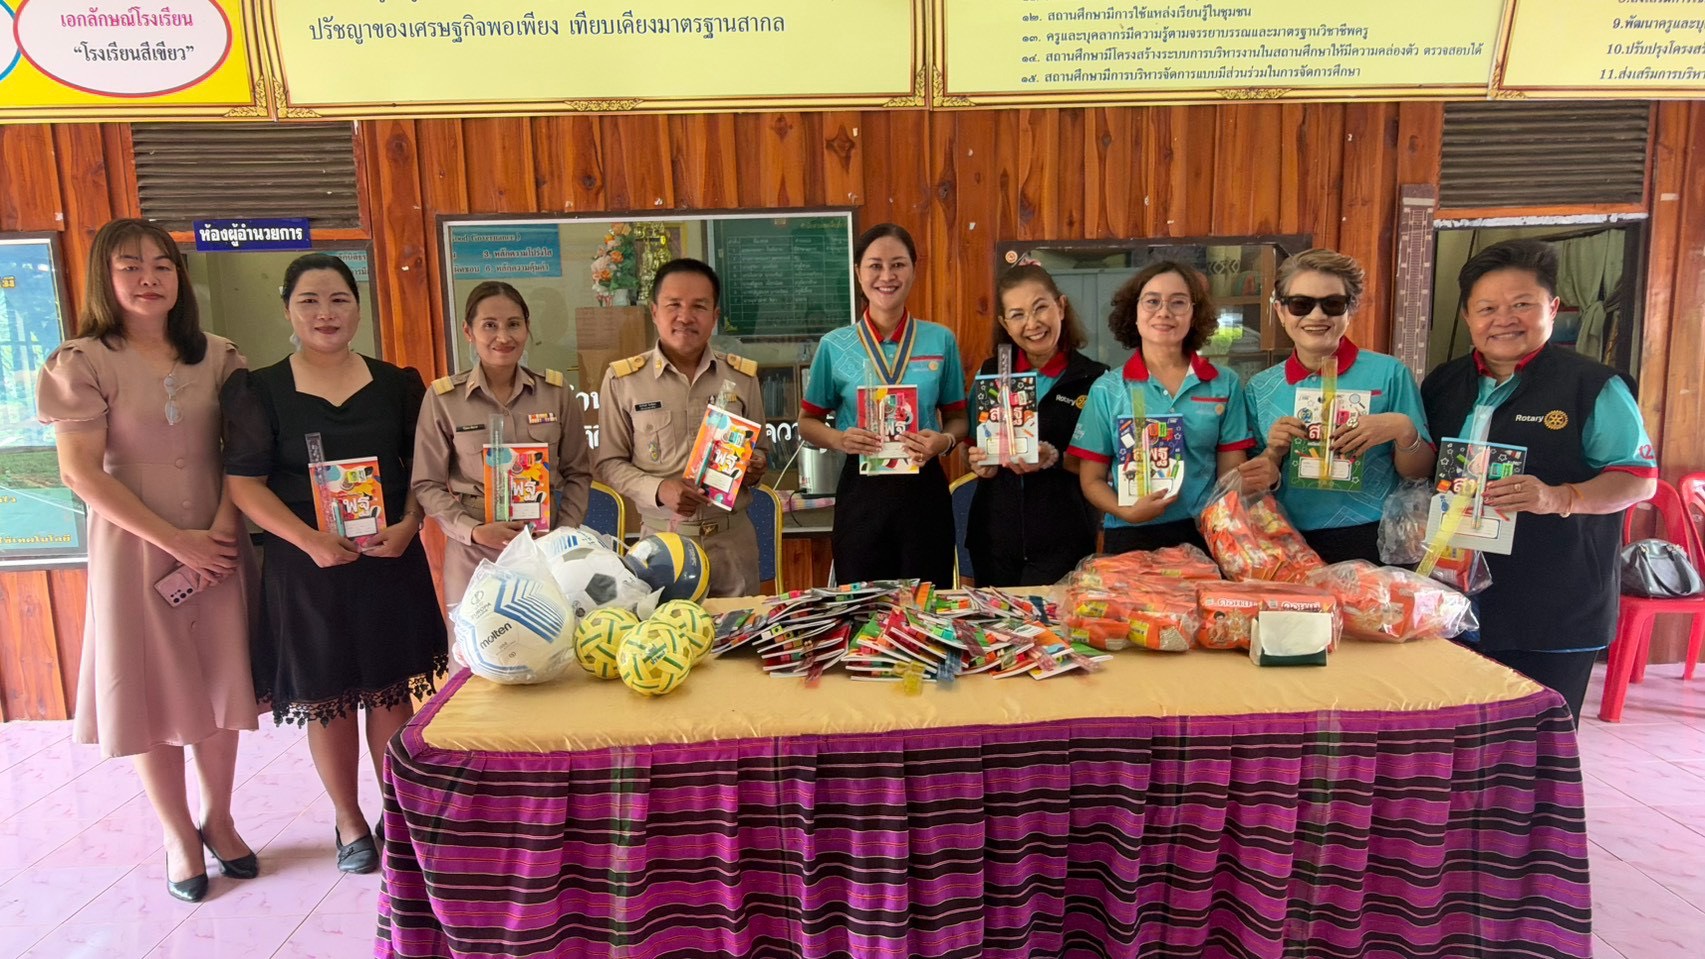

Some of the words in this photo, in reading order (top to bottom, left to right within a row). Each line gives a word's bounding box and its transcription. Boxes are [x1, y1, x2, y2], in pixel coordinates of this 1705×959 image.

[60, 6, 194, 28] เอกลักษณ์โรงเรียน
[1047, 4, 1252, 22] สถานศึกษามีการใช้แหล่งเรียนรู้ในชุมชน
[1613, 15, 1705, 33] 9.พัฒนาครูและบุ
[309, 11, 559, 45] ปรัชญาของเศรษฐกิจพอเพียง
[569, 9, 786, 39] เทียบเคียงมาตรฐานสากล
[73, 40, 195, 62] “โรงเรียนสีเขียว”
[1423, 42, 1484, 56] ตรวจสอบได้
[199, 223, 303, 247] ห้องผู้อำนวยการ
[1515, 414, 1545, 424] Rotary
[480, 622, 512, 649] molten
